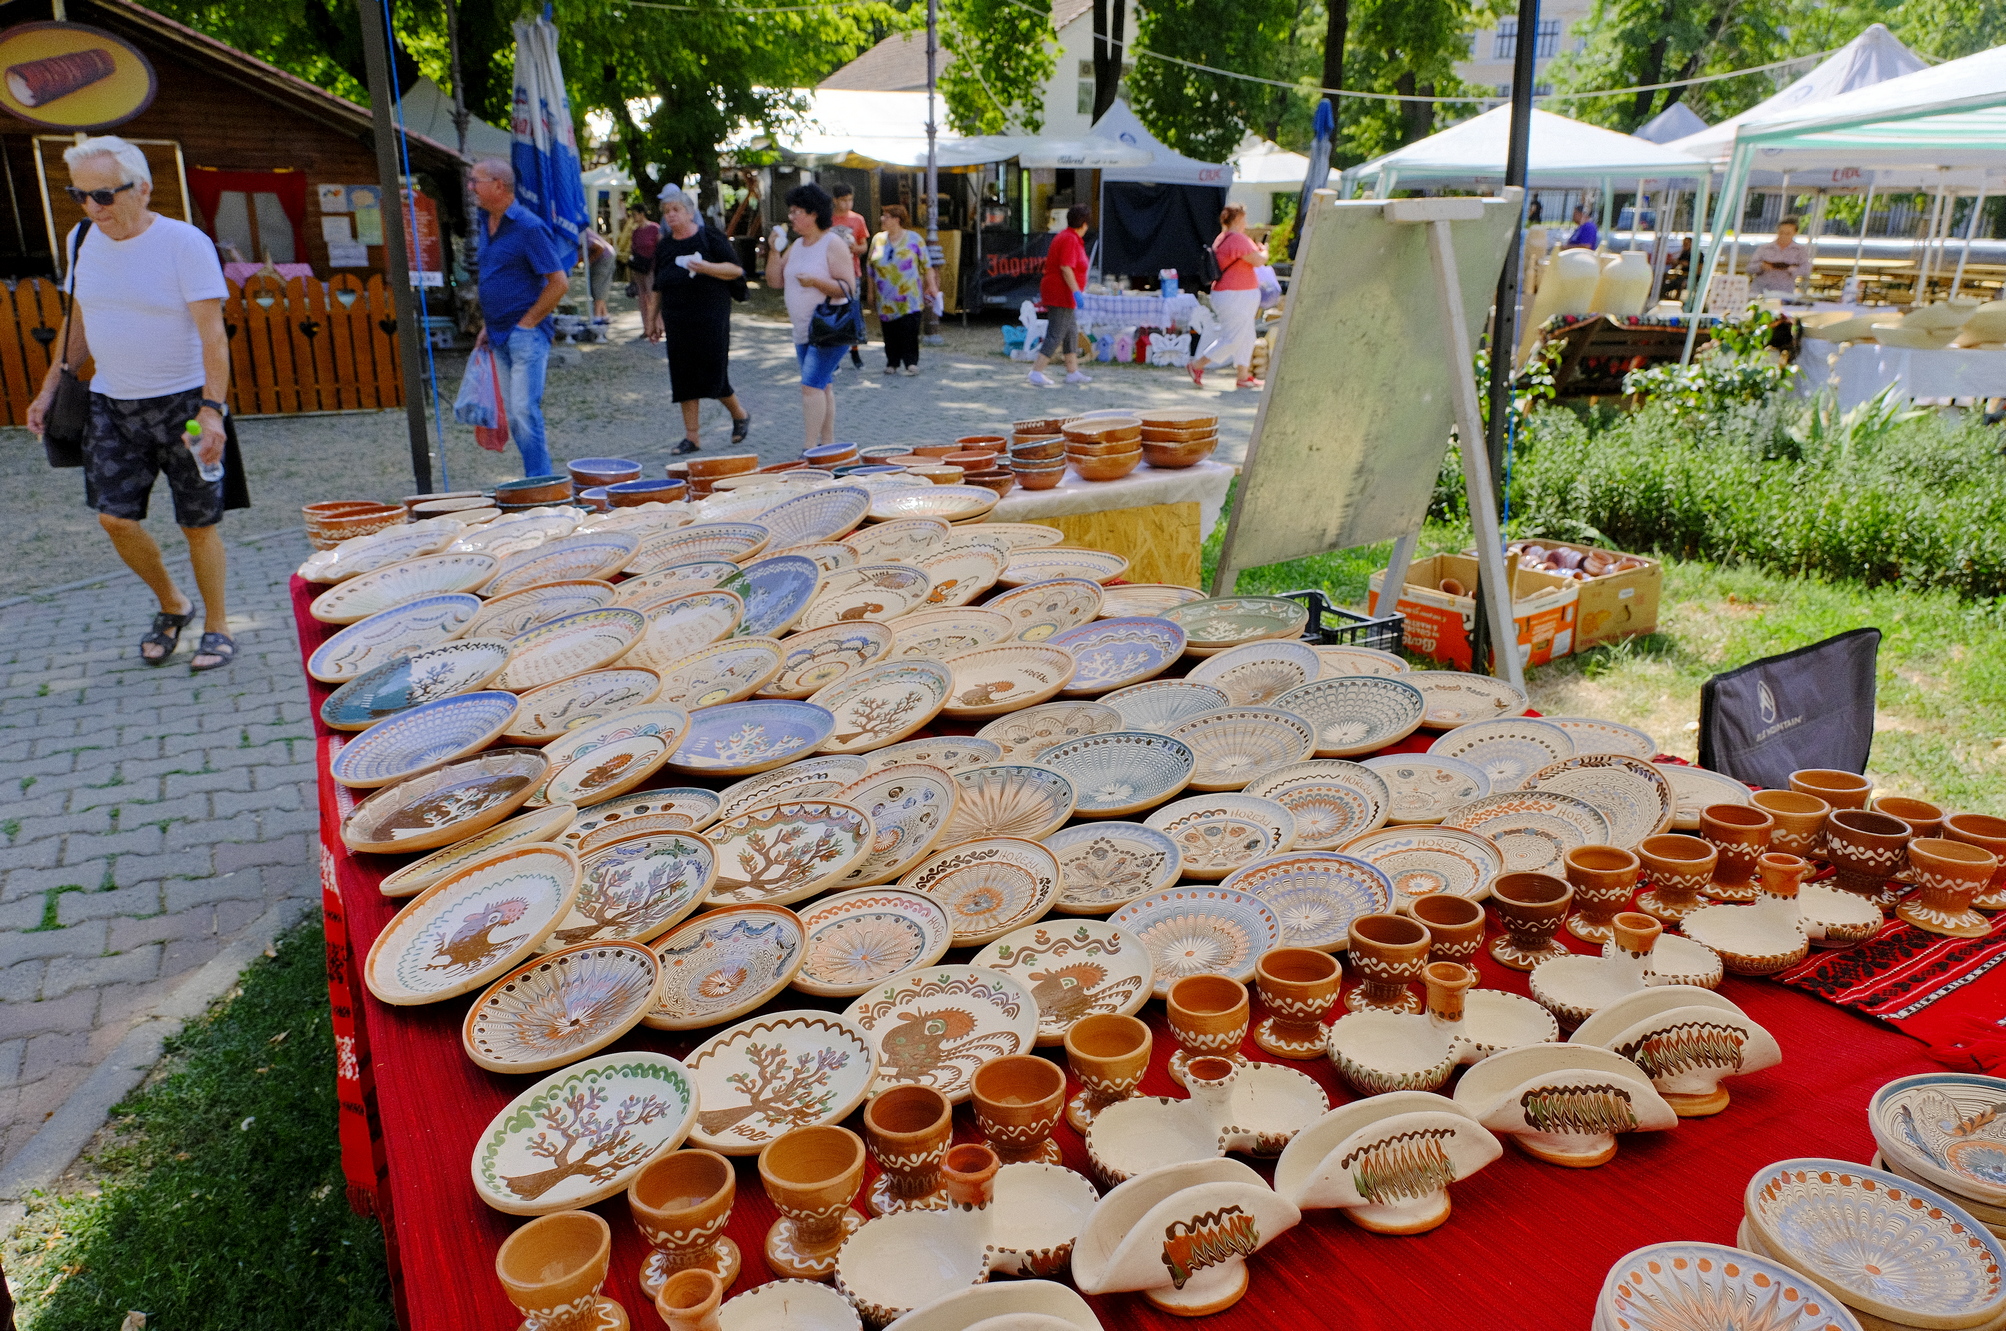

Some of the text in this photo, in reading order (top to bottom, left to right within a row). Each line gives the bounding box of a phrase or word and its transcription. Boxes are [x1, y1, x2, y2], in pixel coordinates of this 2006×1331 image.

[1230, 809, 1272, 826] HOREZU
[1556, 807, 1594, 835] HOREZU
[1418, 838, 1469, 853] HOREZU
